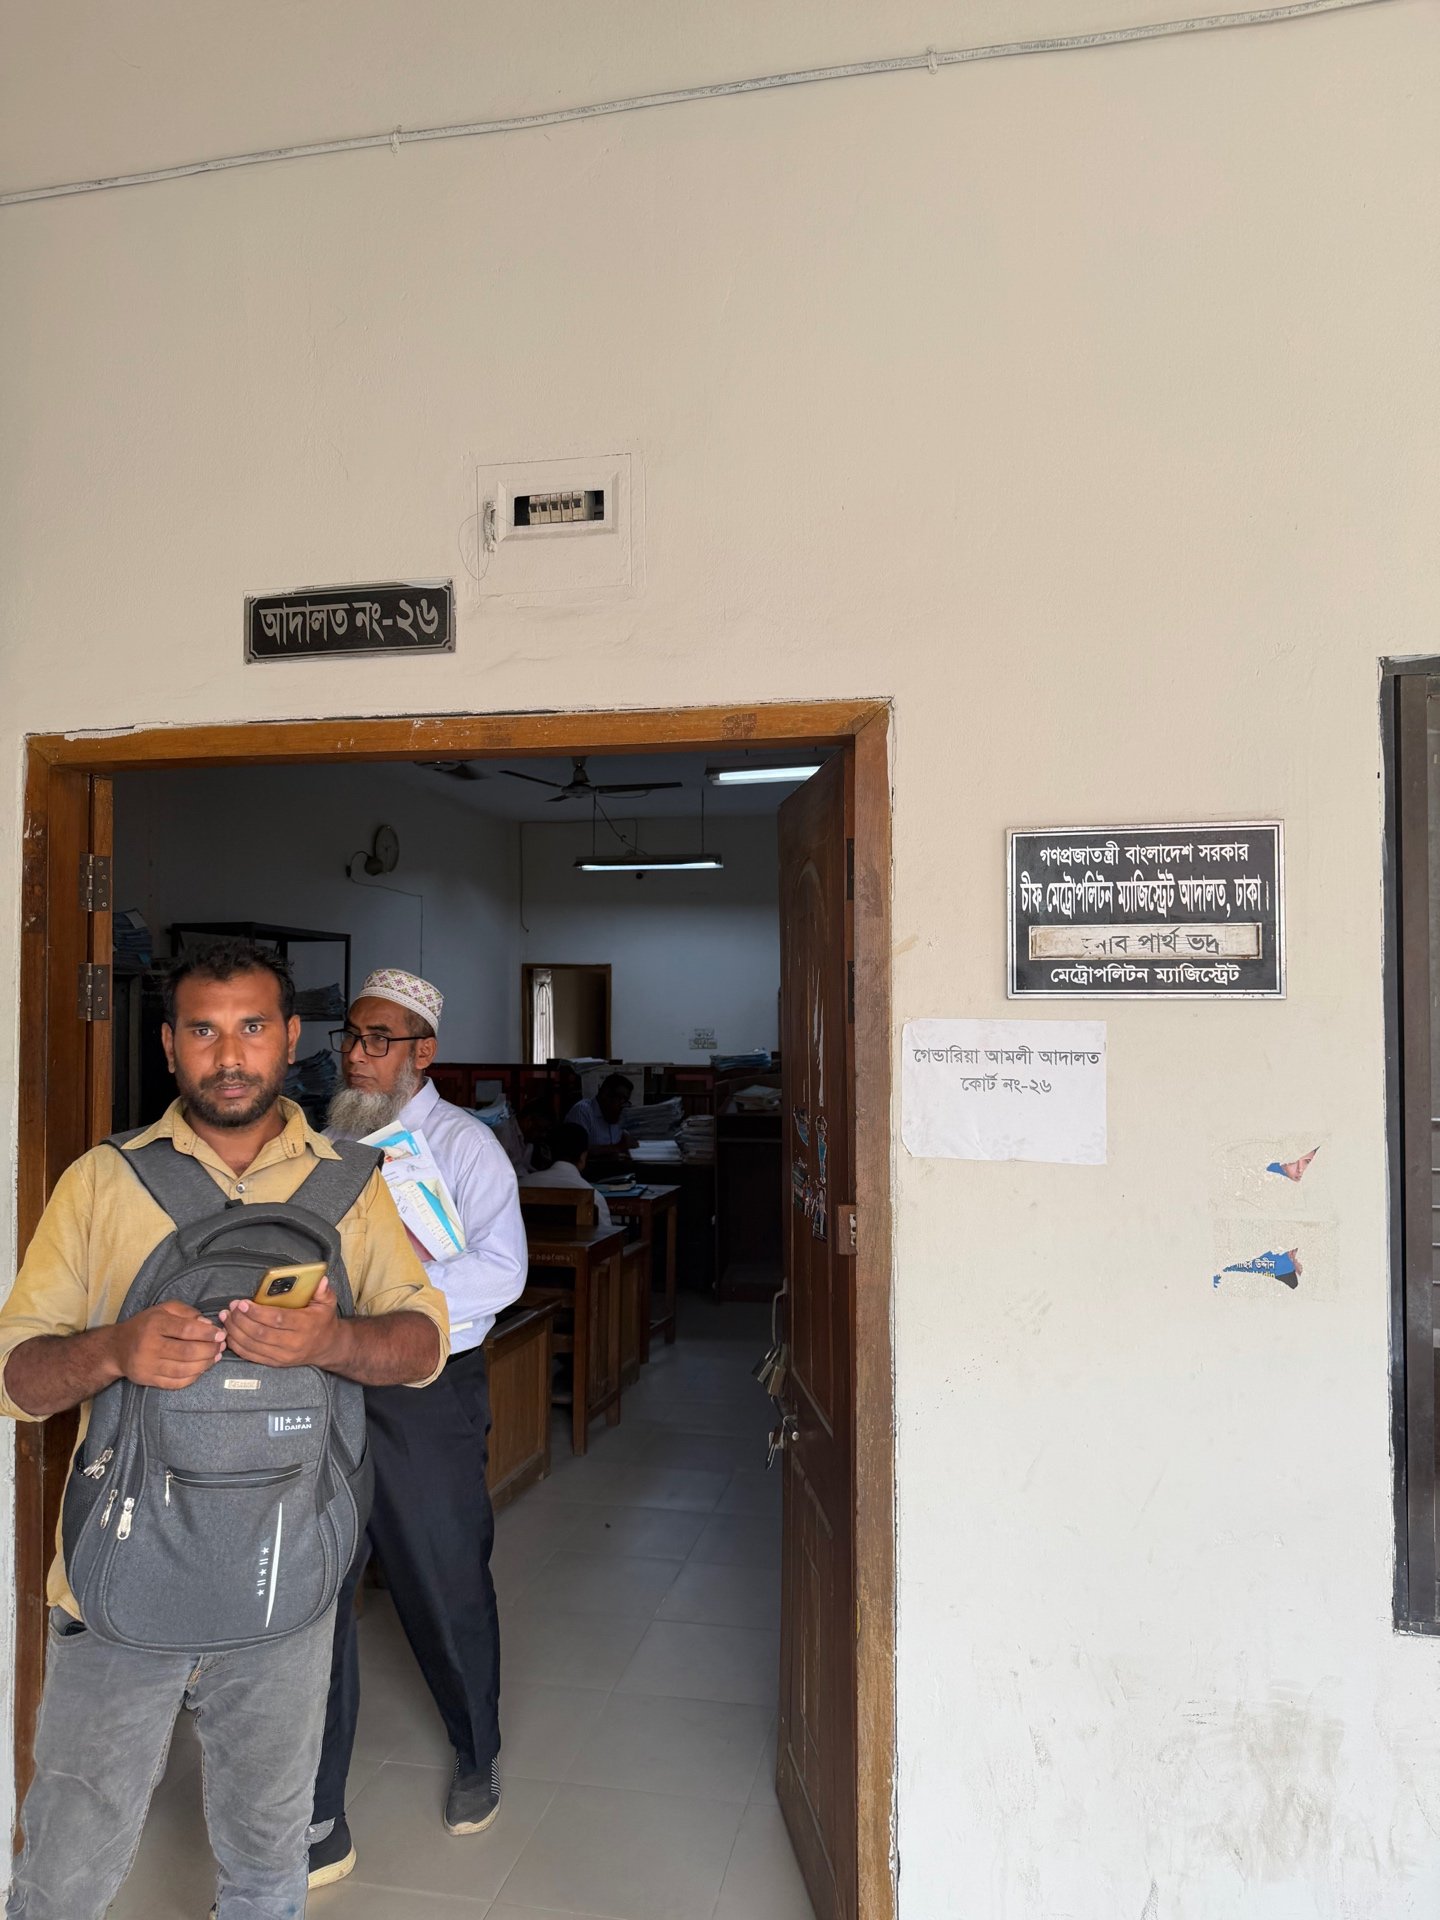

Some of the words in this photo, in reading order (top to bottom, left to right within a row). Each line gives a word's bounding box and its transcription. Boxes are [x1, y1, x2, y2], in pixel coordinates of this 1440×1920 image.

[258, 601, 351, 646] আদালত
[351, 598, 440, 643] নং-২৬
[1039, 840, 1120, 867] গণপ্রজাতন্ত্রী
[1124, 842, 1194, 865] বাংলাদেশ
[1198, 841, 1250, 863] সরকার
[1019, 871, 1043, 914] চীফ
[1046, 870, 1114, 919] মেট্রোপলিটন
[1116, 868, 1176, 918] ম্যাজিস্ট্রেট
[1177, 873, 1232, 918] আদালত,
[1137, 927, 1182, 954] পার্থ
[1185, 934, 1220, 955] ভদ্র
[1050, 963, 1150, 985] মেট্রোপলিটন
[1154, 963, 1242, 985] ম্যাজিস্ট্রেট
[984, 1045, 1034, 1065] আমলী
[1038, 1049, 1102, 1066] আদালত
[960, 1073, 998, 1093] কোর্ট
[1001, 1077, 1052, 1095] নং-২৬
